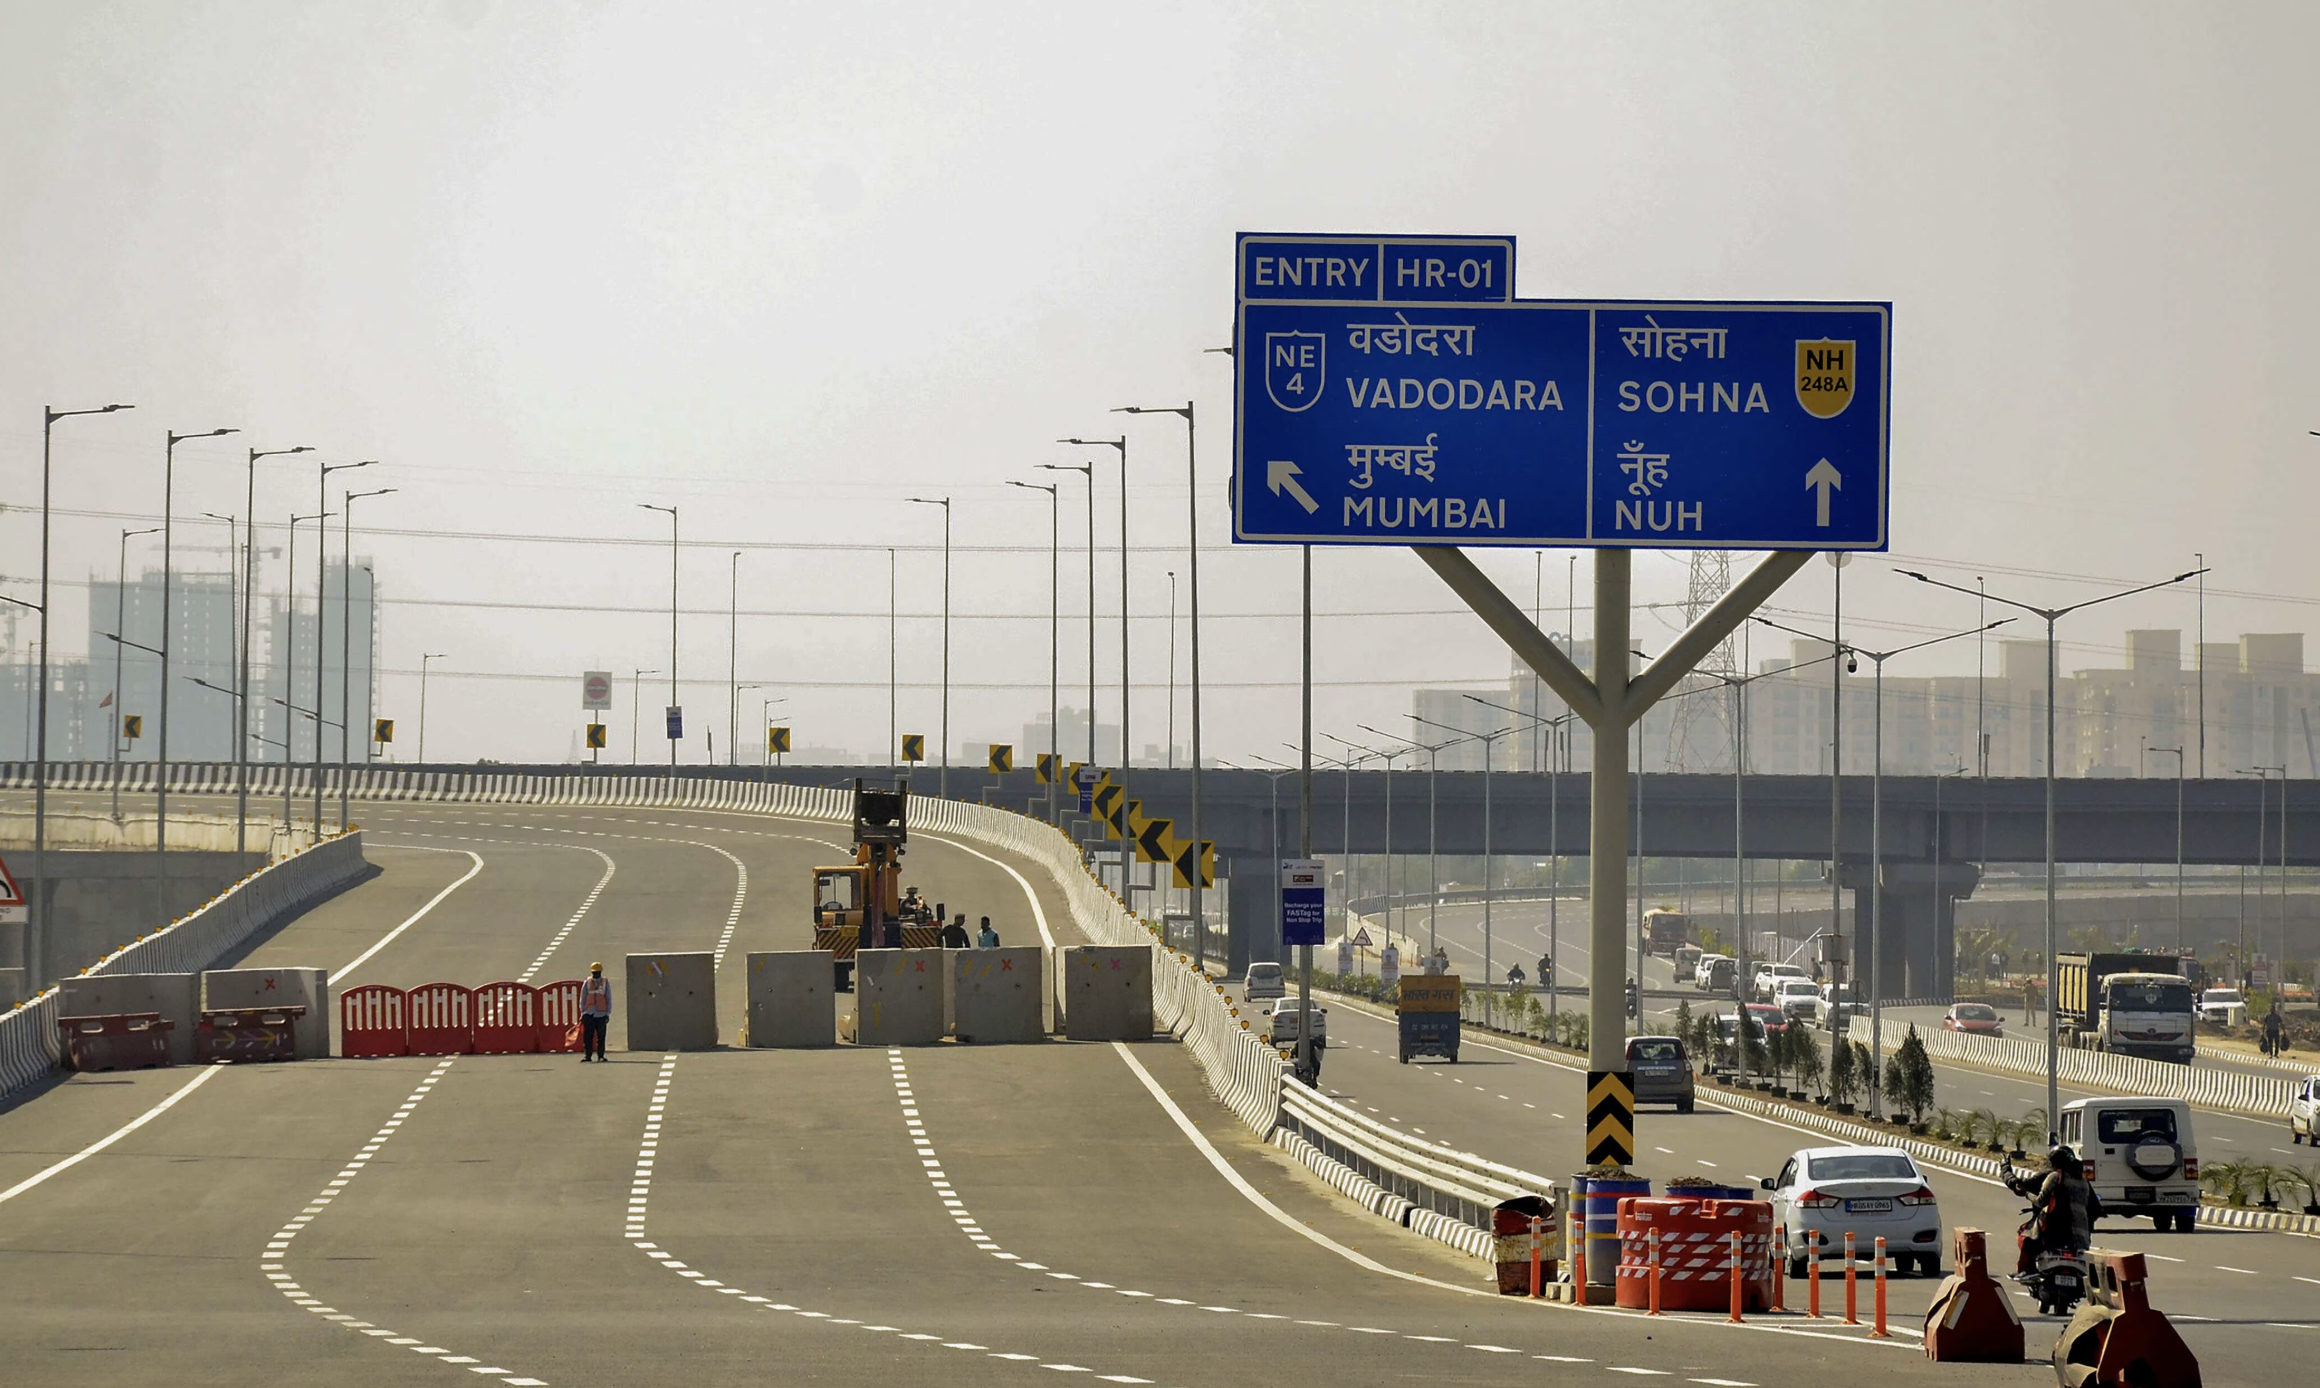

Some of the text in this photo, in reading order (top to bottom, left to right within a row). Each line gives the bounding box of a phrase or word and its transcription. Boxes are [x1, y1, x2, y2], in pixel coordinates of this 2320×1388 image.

[1255, 257, 1370, 287] ENTRY
[1397, 258, 1493, 289] HR-01
[1346, 311, 1476, 357] वडोदरा
[1618, 314, 1729, 362] सोहना
[1275, 344, 1316, 368] NE
[1805, 349, 1845, 371] NH
[1286, 372, 1305, 395] 4
[1345, 377, 1565, 412] VADODARA
[1617, 380, 1771, 414] SOHNA
[1800, 376, 1849, 393] 248A
[1344, 433, 1439, 490] मुम्बई
[1616, 439, 1671, 497] नूँह
[1343, 496, 1507, 529] MUMBAI
[1615, 499, 1703, 532] NUH
[1286, 909, 1311, 917] FASTag
